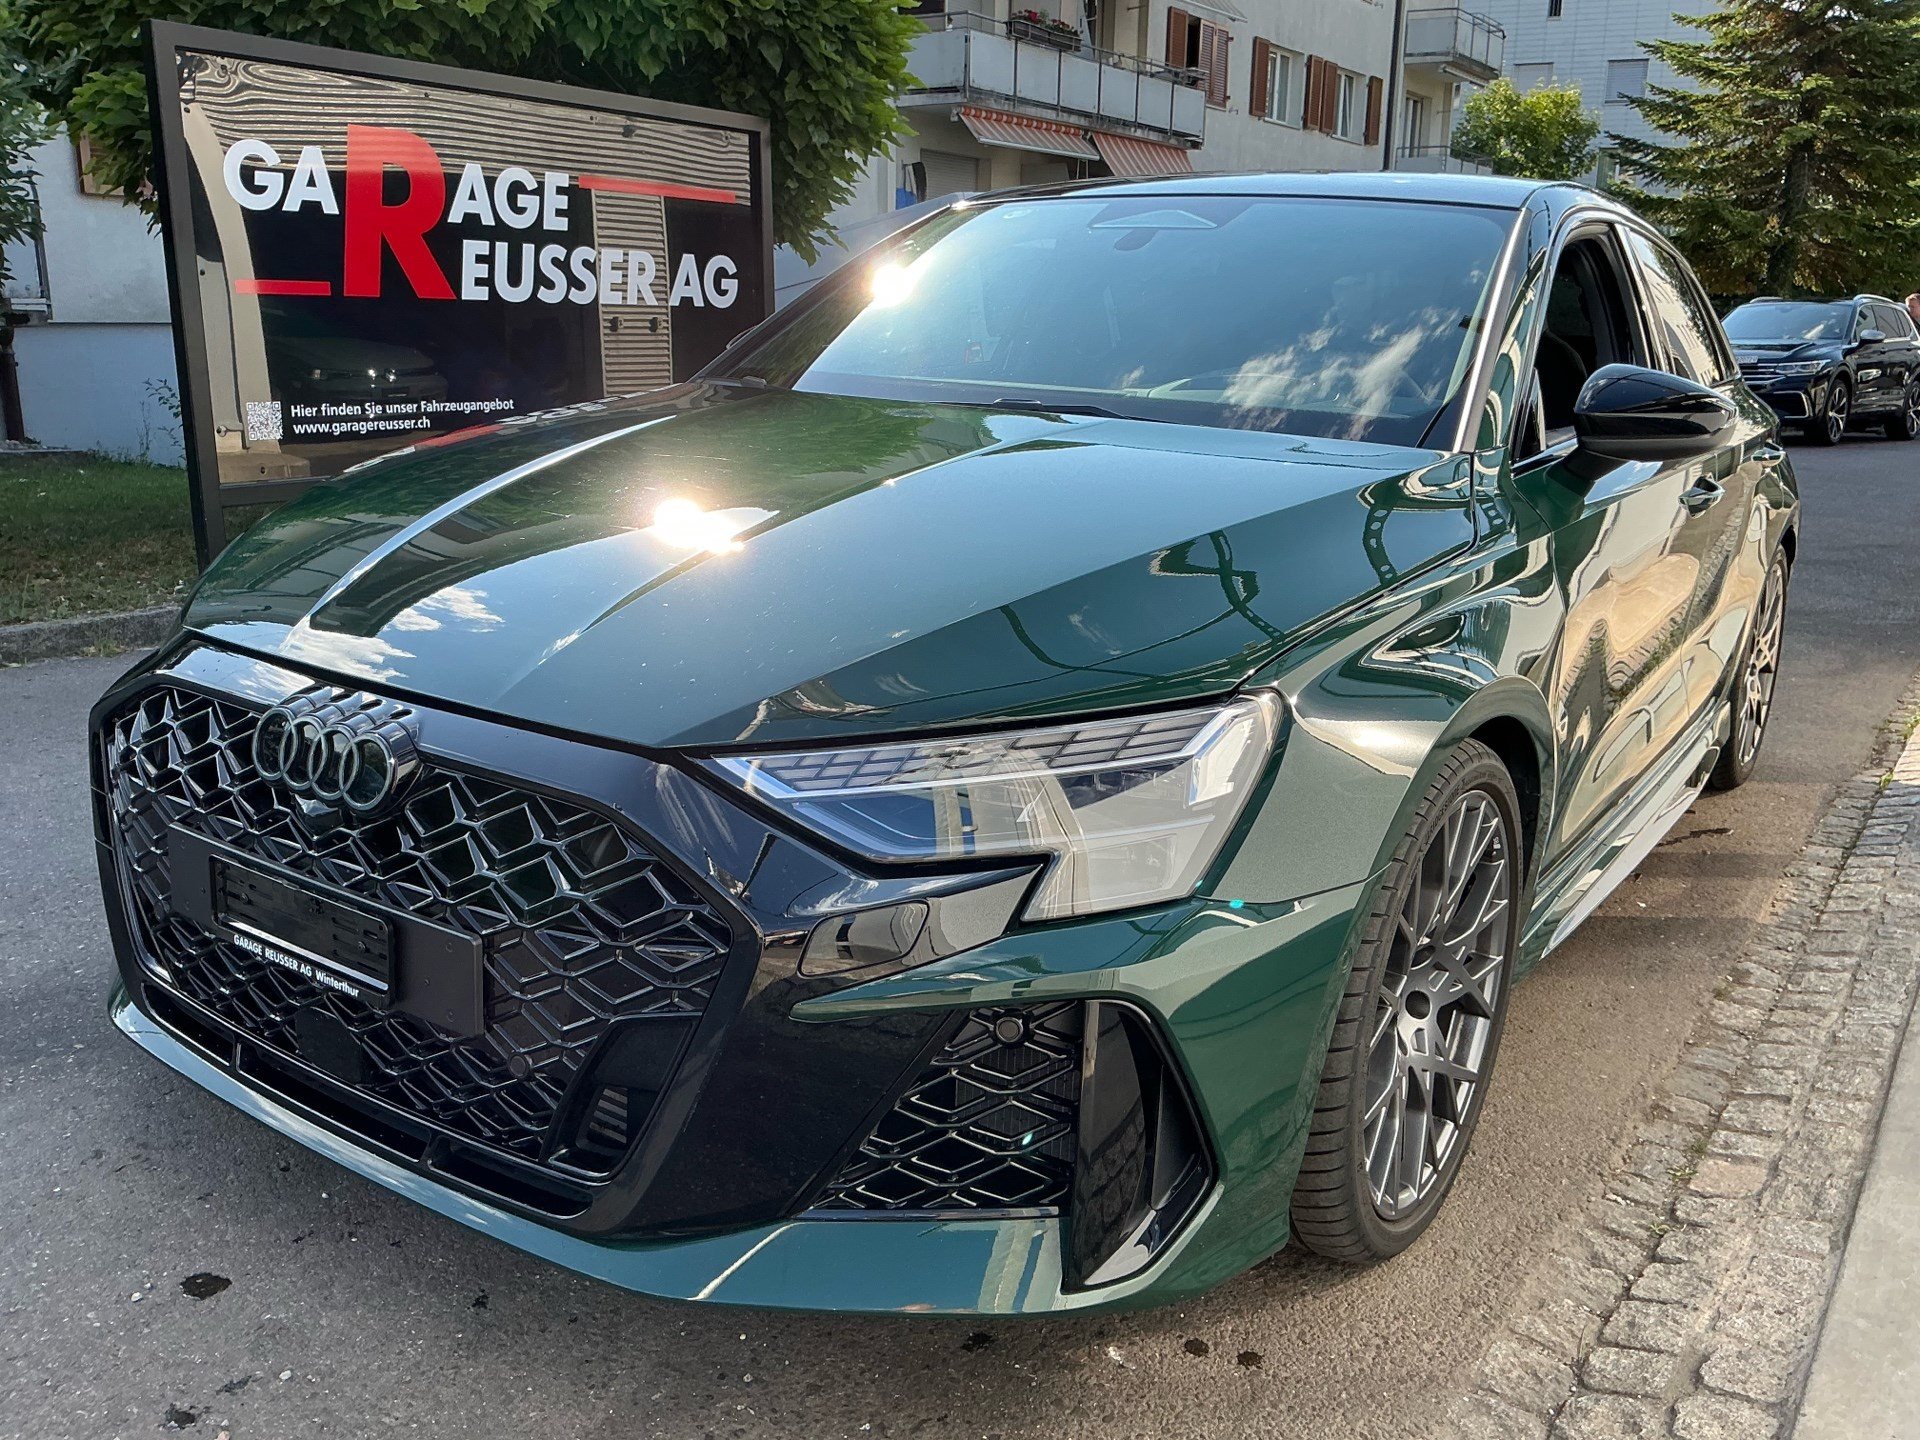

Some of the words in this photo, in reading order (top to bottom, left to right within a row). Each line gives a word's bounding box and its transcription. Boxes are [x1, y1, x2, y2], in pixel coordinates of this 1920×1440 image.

[223, 124, 570, 299] GARAGE
[668, 253, 739, 308] AG
[290, 404, 318, 418] Hier
[320, 402, 362, 416] finden
[365, 402, 383, 414] Sie
[386, 403, 418, 414] unser
[420, 398, 515, 413] Fahrzeugangebot
[292, 415, 431, 435] www.garagereusser.ch
[233, 934, 263, 956] GARAGE
[265, 947, 298, 971] REUSSER
[300, 963, 313, 977] AG
[315, 970, 360, 997] Winterthur
